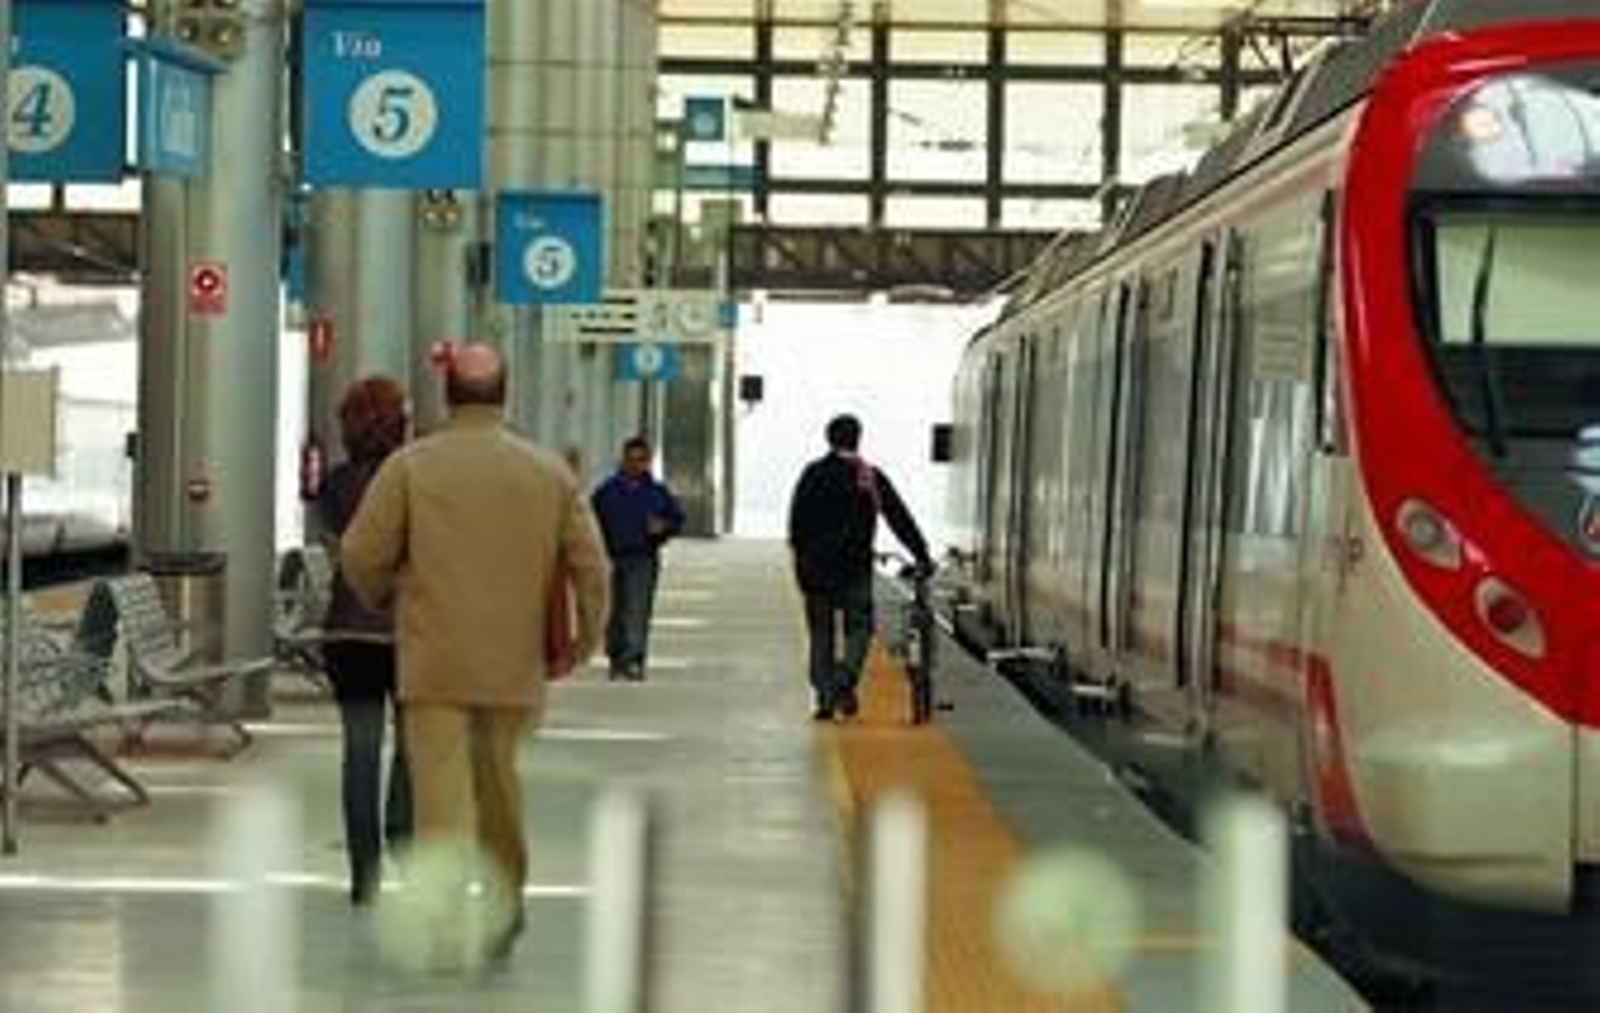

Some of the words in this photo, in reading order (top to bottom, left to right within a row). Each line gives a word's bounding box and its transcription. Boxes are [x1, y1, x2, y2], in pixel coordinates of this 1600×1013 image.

[12, 83, 52, 139] 4
[372, 87, 414, 143] 5
[536, 246, 561, 278] 5
